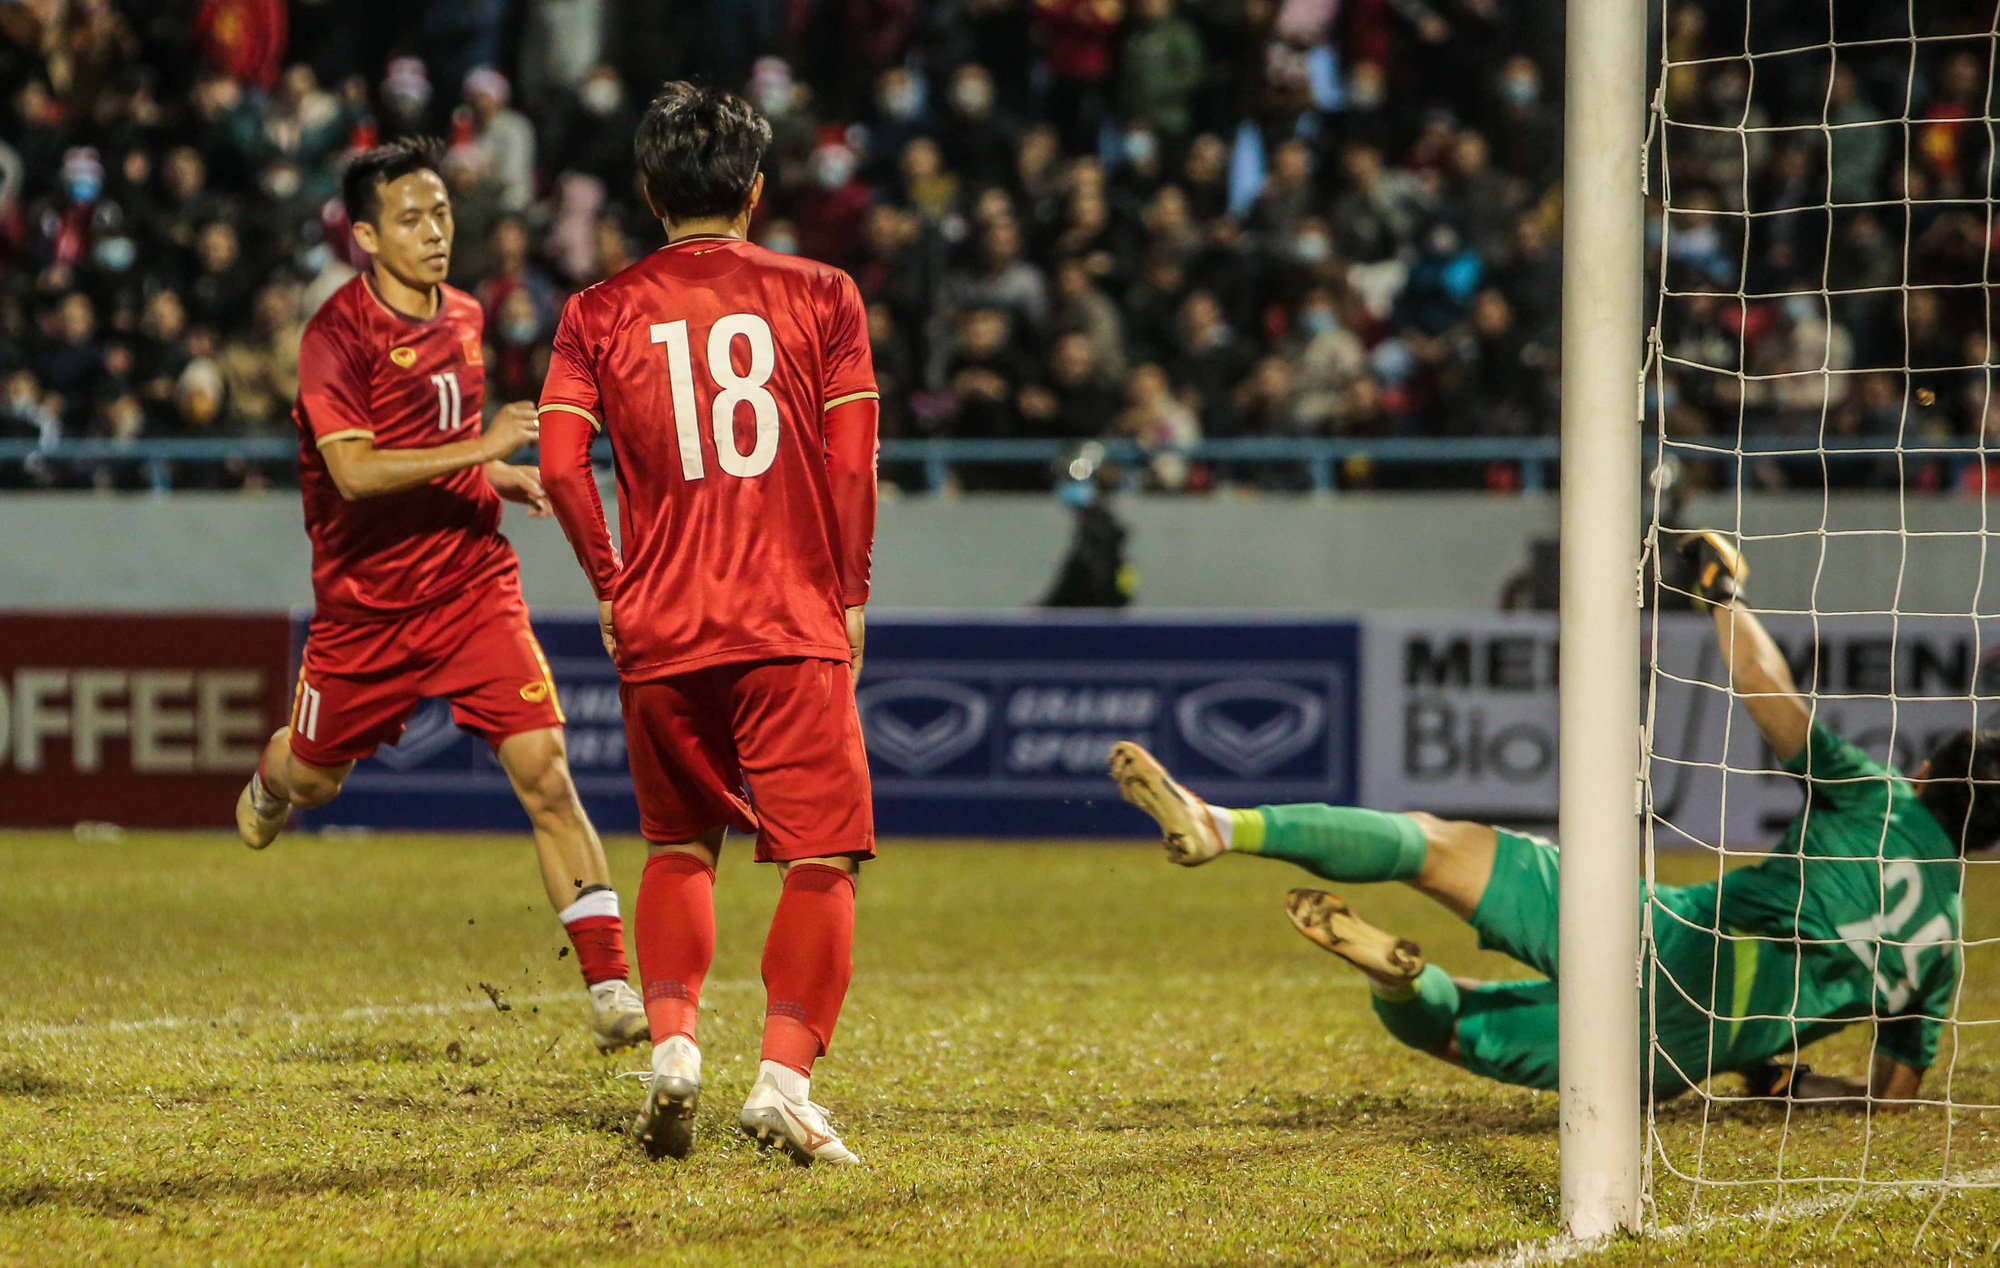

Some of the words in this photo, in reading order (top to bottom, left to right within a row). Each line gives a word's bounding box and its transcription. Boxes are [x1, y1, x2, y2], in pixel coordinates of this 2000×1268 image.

[431, 372, 461, 431] 11
[650, 313, 780, 481] 18
[1404, 635, 1561, 691] ME
[0, 667, 265, 773] FFEE
[297, 681, 320, 741] 11
